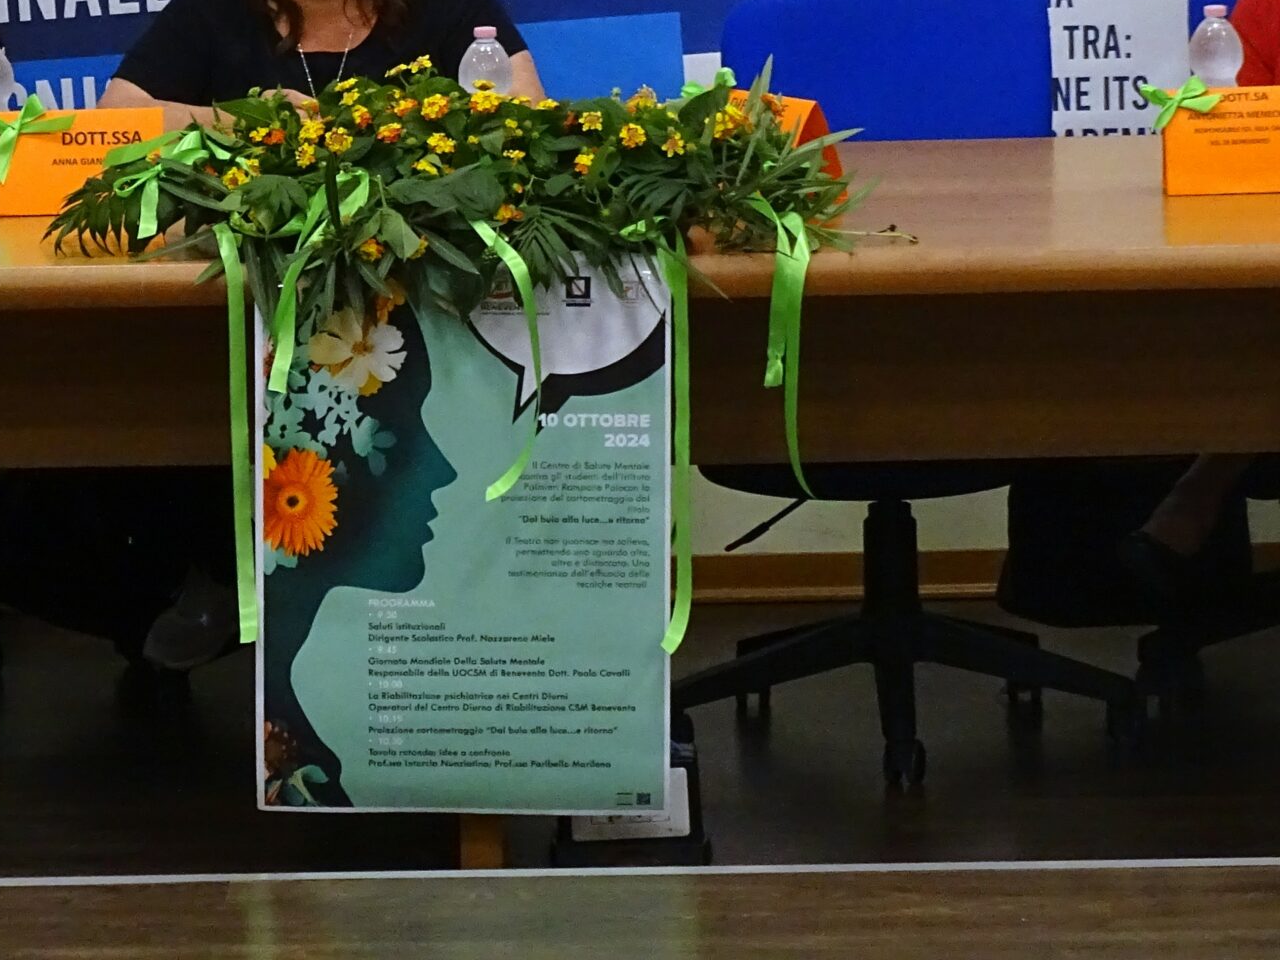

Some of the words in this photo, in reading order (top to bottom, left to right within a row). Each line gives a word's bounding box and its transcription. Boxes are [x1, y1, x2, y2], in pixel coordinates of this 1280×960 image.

[1062, 24, 1133, 60] TRA:
[1104, 75, 1150, 111] ITS
[61, 130, 143, 146] DOTT.SSA
[52, 158, 78, 167] ANNA
[538, 412, 559, 428] 10
[562, 412, 652, 428] OTTOBRE
[603, 433, 651, 448] 2024
[368, 599, 436, 608] PROGRAMMA
[368, 622, 393, 631] Saluti
[395, 622, 447, 631] istituzionali
[368, 634, 410, 644] Dirigente
[411, 634, 455, 644] Scolastico
[456, 634, 478, 644] Prof.
[479, 634, 528, 644] Nazzareno
[530, 634, 556, 644] Miele
[368, 657, 408, 665] Giornata
[409, 657, 451, 665] Mondiale
[453, 657, 477, 665] Della
[479, 657, 507, 665] Salute
[509, 657, 546, 665] Mentale
[368, 668, 425, 677] Responsabile
[427, 668, 450, 677] della
[452, 668, 487, 677] UOCSM
[489, 668, 498, 677] di
[500, 668, 546, 677] Benevento
[548, 668, 570, 677] Dott.
[572, 668, 598, 677] Paolo
[599, 668, 631, 677] Cavalli
[368, 692, 379, 701] La
[381, 692, 441, 701] Riabilitazione
[443, 692, 494, 701] psichiatrica
[496, 692, 510, 701] nei
[512, 692, 539, 701] Centri
[541, 692, 569, 701] Diurni
[368, 703, 412, 712] Operatori
[414, 703, 429, 712] del
[430, 703, 460, 712] Centro
[462, 703, 493, 712] Diurno
[494, 703, 503, 712] di
[505, 703, 566, 712] Riabilitazione
[568, 703, 589, 712] CSM
[591, 703, 637, 712] Benevento
